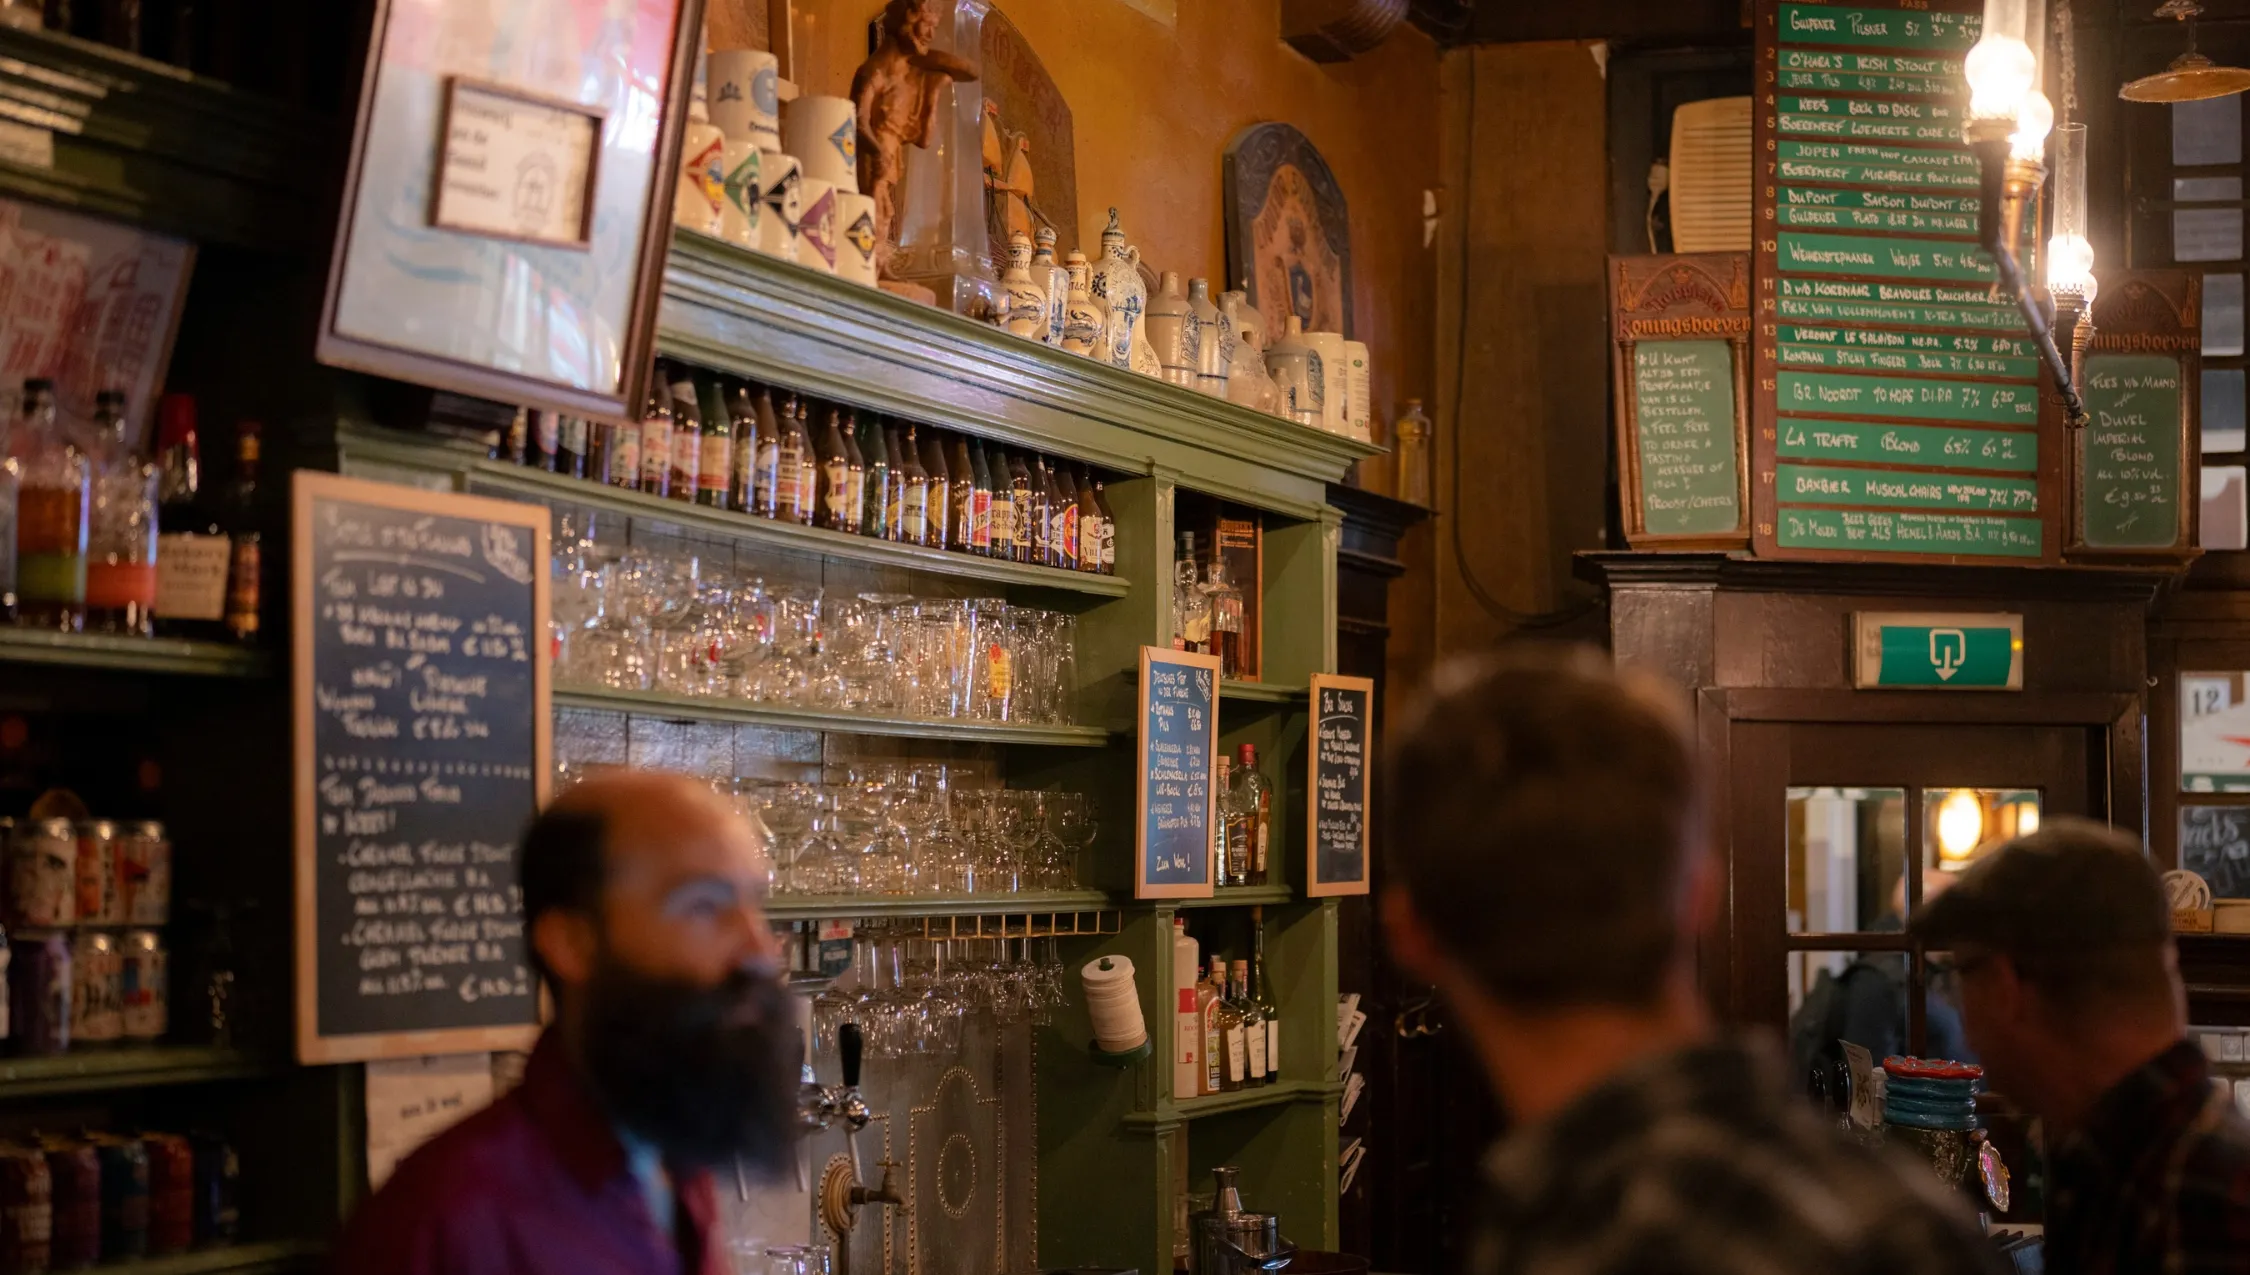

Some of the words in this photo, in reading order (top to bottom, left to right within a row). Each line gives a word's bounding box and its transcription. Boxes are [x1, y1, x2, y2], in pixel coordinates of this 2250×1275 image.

[1767, 14, 1774, 26] 1
[1847, 13, 1888, 36] PILSNER
[1905, 21, 1920, 36] 5%
[1767, 48, 1775, 58] 2
[1857, 56, 1888, 70] IRISH
[1894, 59, 1936, 72] STOUT
[1766, 72, 1775, 82] 3
[1766, 94, 1774, 106] 4
[1767, 117, 1775, 129] 5
[1767, 140, 1776, 151] 6
[1796, 145, 1840, 157] JOPEN
[1903, 155, 1950, 166] CASCADE
[1768, 163, 1776, 174] 7
[1861, 168, 1922, 183] MIRABELLE
[1766, 186, 1775, 198] 8
[1788, 188, 1840, 204] DUPONT
[1862, 193, 1905, 208] SAISON
[1911, 196, 1956, 210] DUPONT
[1765, 208, 1774, 219] 9
[1761, 240, 1777, 252] 10
[1763, 278, 1774, 290] 11
[1879, 285, 1932, 300] BRAVOURE
[1763, 299, 1775, 310] 12
[1618, 312, 1751, 338] Koningshoeven
[1763, 324, 1776, 336] 13
[1763, 348, 1776, 359] 14
[1870, 352, 1906, 368] FINGERS
[1762, 379, 1775, 391] 15
[2141, 376, 2176, 389] MAAND
[1962, 388, 1980, 408] 7%
[2099, 411, 2146, 427] DUVEL
[1763, 429, 1775, 440] 16
[1785, 426, 1806, 446] LA
[1881, 432, 1920, 452] BLOND
[2094, 431, 2145, 445] IMPERIAL
[2111, 447, 2154, 462] BLOND
[1762, 472, 1775, 484] 17
[1866, 481, 1907, 498] MUSICAL
[1909, 484, 1942, 500] CHAIRS
[1758, 524, 1772, 535] 18
[2194, 689, 2219, 715] 12
